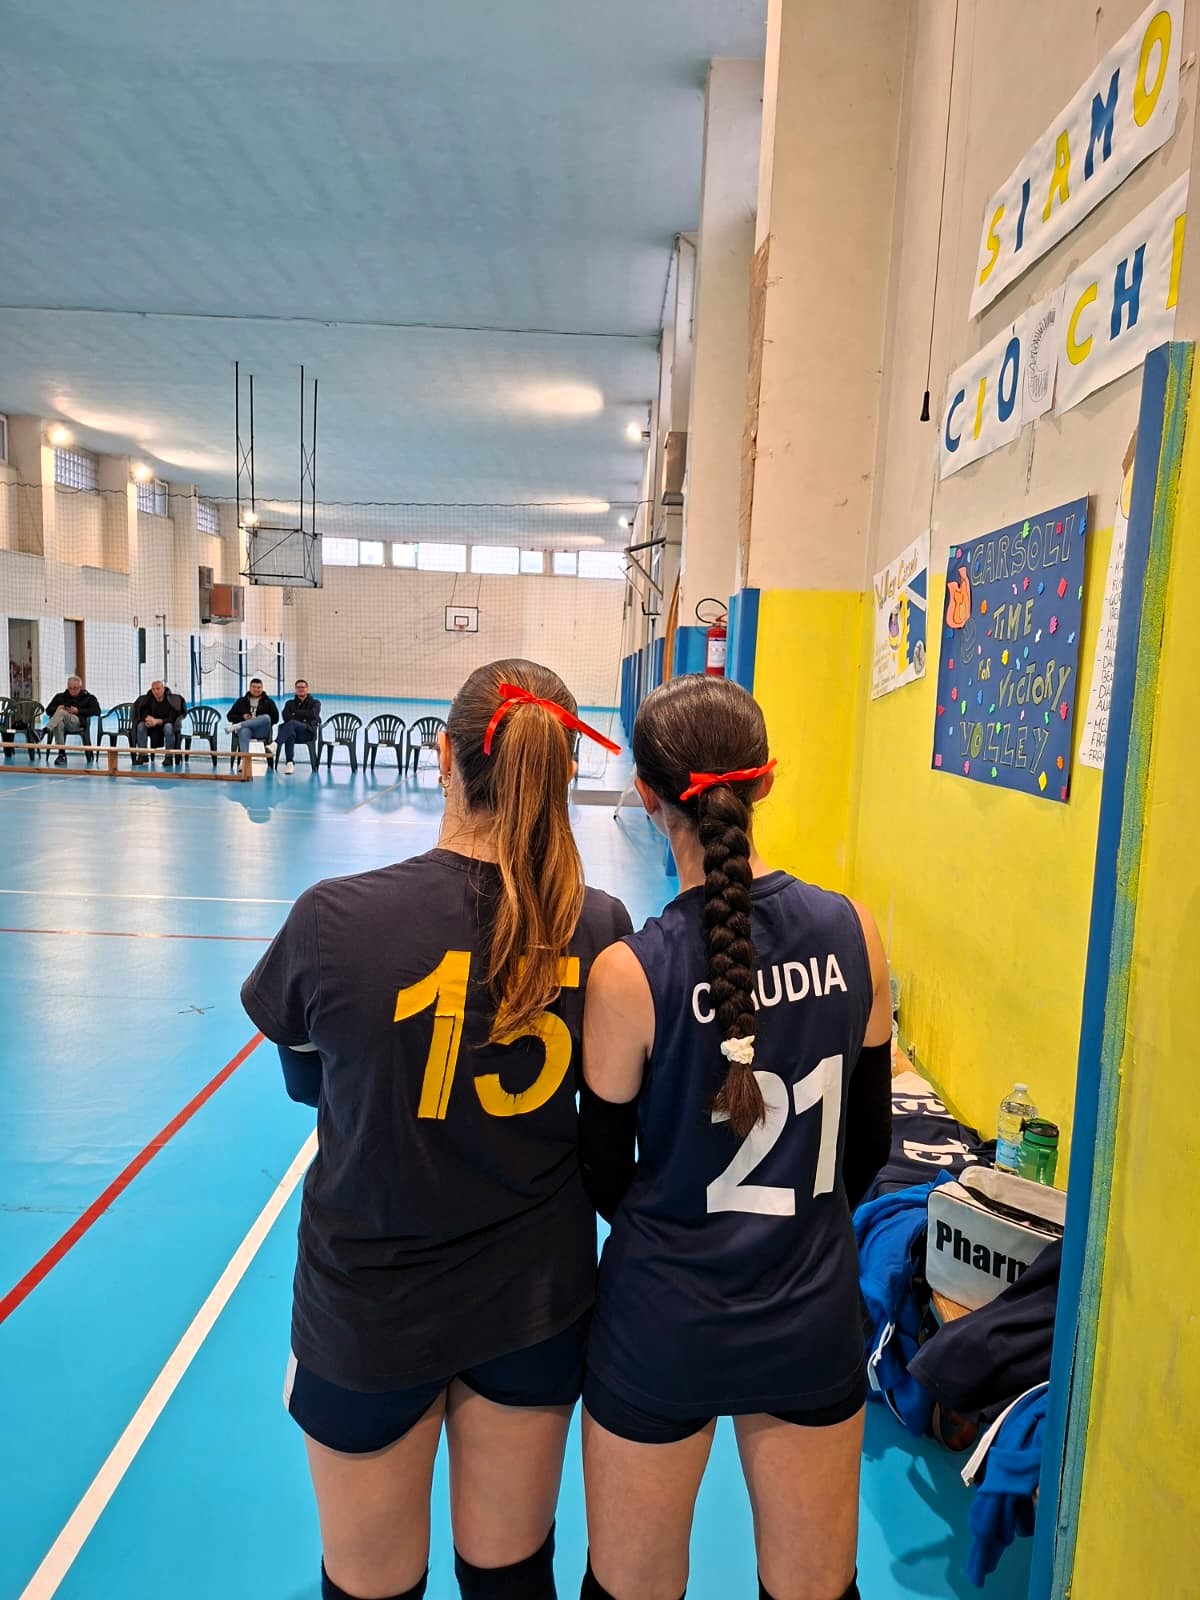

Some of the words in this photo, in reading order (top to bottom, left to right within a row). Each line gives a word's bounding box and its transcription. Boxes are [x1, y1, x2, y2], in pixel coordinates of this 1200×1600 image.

[979, 10, 1172, 286] SIAMO
[969, 514, 1075, 586] CARSOLI
[959, 721, 1050, 774] VOLLEY
[394, 950, 580, 1120] 15
[692, 953, 848, 1024] CUDIA
[706, 1054, 844, 1216] 21
